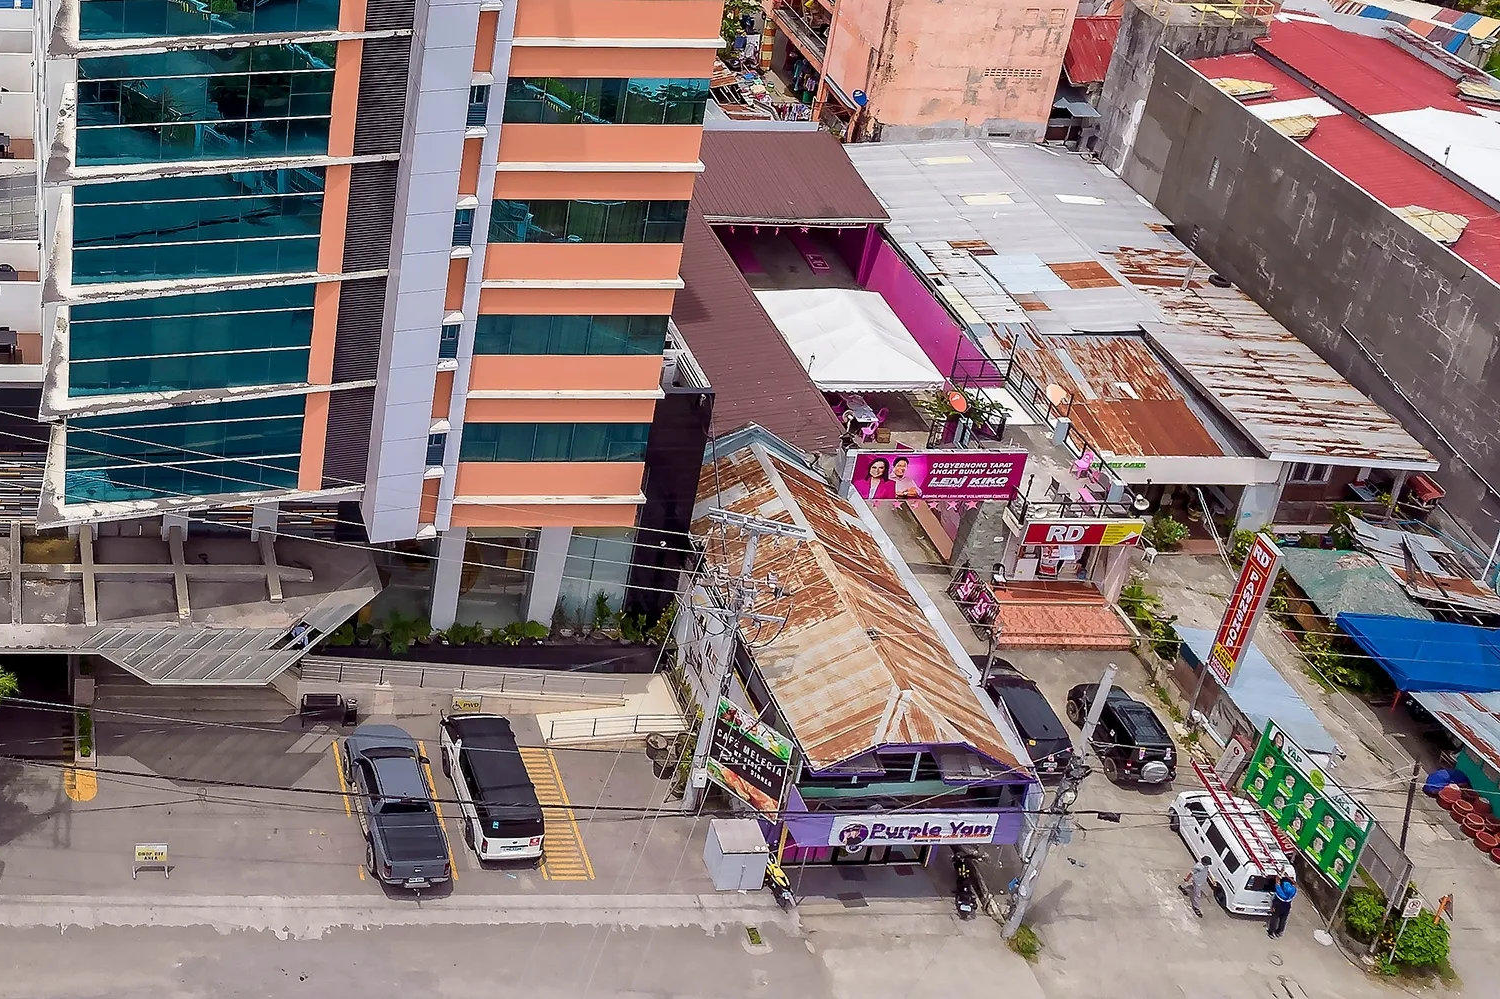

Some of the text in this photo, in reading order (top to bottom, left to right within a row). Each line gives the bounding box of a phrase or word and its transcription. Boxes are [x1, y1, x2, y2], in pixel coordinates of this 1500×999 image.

[968, 476, 1009, 486] KIKO
[1045, 525, 1085, 542] RD
[1253, 545, 1271, 568] RD
[1226, 571, 1259, 648] PAWNSHOP
[743, 745, 782, 777] MELECIA
[1287, 746, 1303, 763] YAP
[869, 821, 992, 840] Purple Yam
